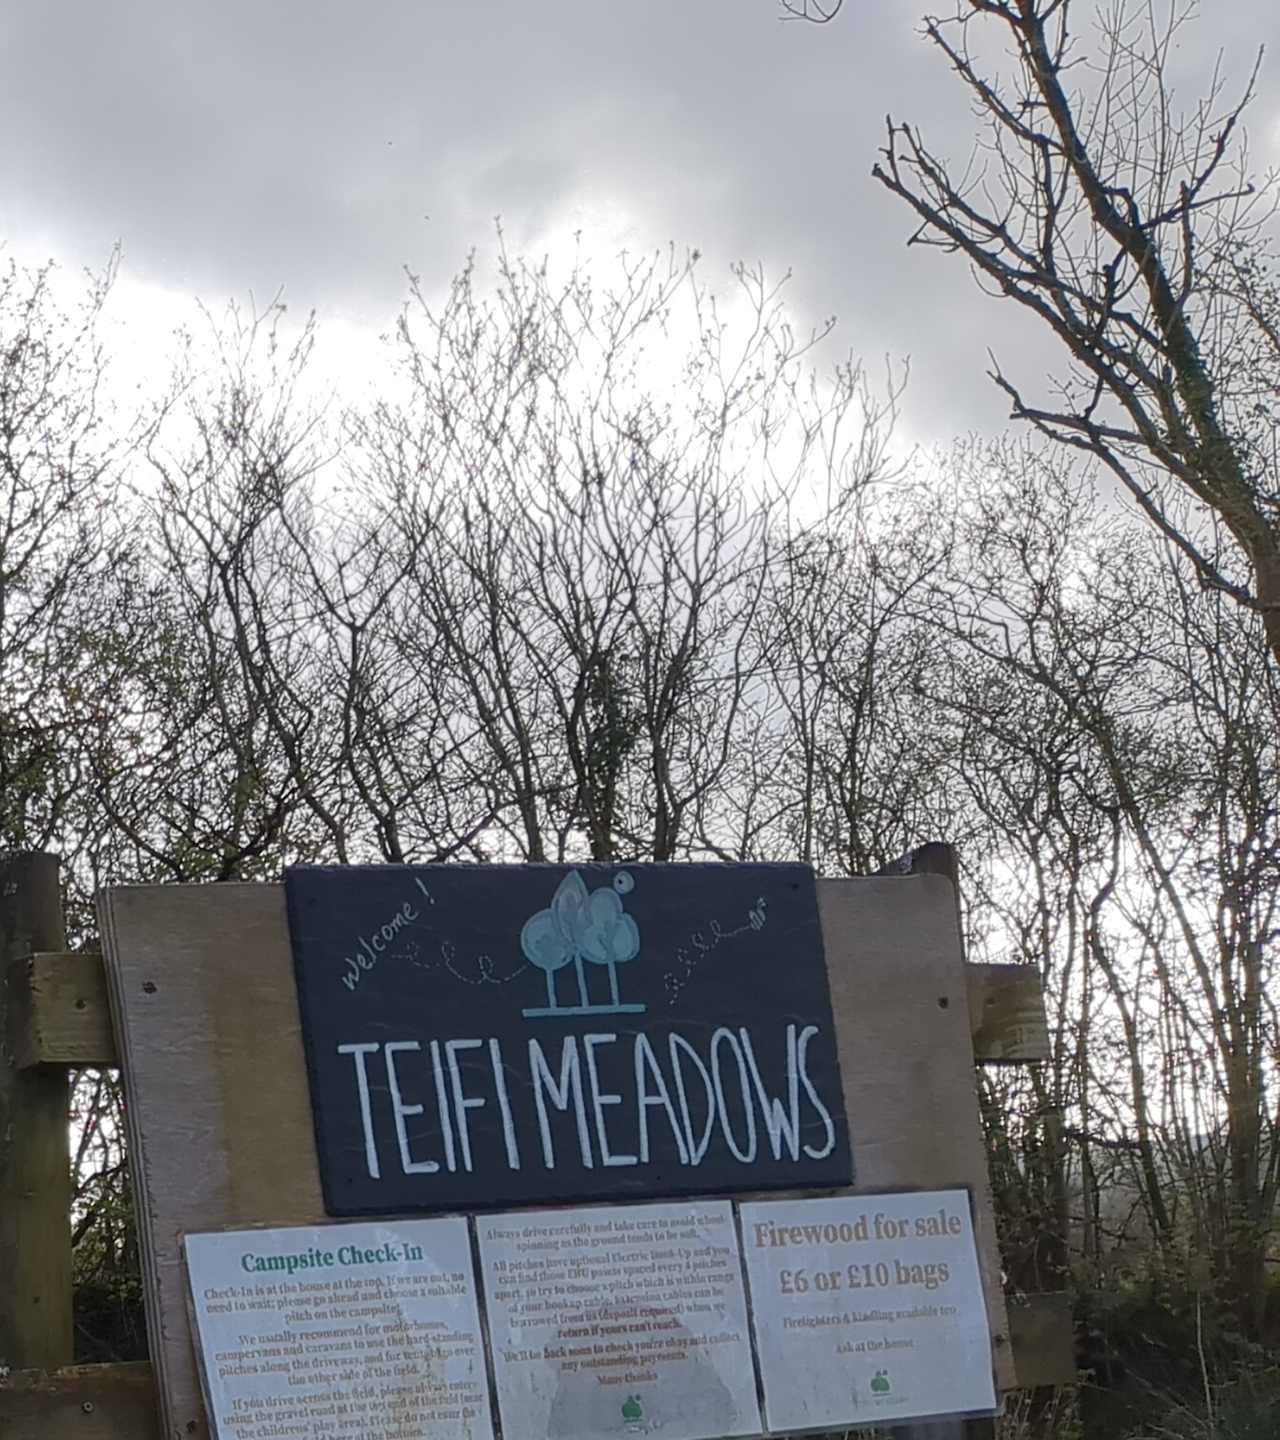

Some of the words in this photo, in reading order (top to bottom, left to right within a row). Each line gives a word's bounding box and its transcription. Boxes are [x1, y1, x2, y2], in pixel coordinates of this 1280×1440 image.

[338, 1037, 520, 1179] TEIFI
[528, 1024, 836, 1170] MEADOWS
[487, 1229, 520, 1242] Always
[522, 1227, 547, 1237] drive
[550, 1223, 591, 1236] carefully
[594, 1221, 612, 1232] and
[614, 1220, 634, 1231] take
[637, 1220, 656, 1229] care
[671, 1215, 696, 1227] avoid
[753, 1214, 869, 1248] Firewood
[873, 1212, 910, 1239] for
[915, 1209, 961, 1237] sale
[517, 1238, 559, 1253] spinning
[574, 1235, 589, 1246] the
[591, 1232, 626, 1248] ground
[240, 1247, 334, 1274] Campsite
[337, 1242, 424, 1267] Check-In
[493, 1260, 506, 1271] All
[509, 1258, 544, 1274] pitches
[546, 1257, 567, 1267] have
[592, 1266, 622, 1280] points
[624, 1262, 656, 1277] spaced
[658, 1262, 682, 1274] every
[780, 1269, 809, 1294] £6
[815, 1270, 841, 1291] or
[848, 1262, 888, 1289] £10
[894, 1259, 949, 1290] bags
[204, 1286, 252, 1299] Check-In
[279, 1283, 296, 1294] the
[298, 1282, 330, 1292] house
[344, 1278, 362, 1289] the
[413, 1275, 428, 1284] are
[538, 1286, 552, 1299] try
[610, 1278, 634, 1294] pitch
[636, 1276, 664, 1288] which
[206, 1301, 232, 1312] need
[278, 1296, 310, 1311] please
[328, 1291, 358, 1304] ahead
[360, 1290, 380, 1301] and
[285, 1309, 312, 1325] pitch
[330, 1307, 347, 1318] the
[784, 1315, 840, 1329] Firelighters
[852, 1310, 894, 1322] kindling
[258, 1330, 297, 1343] usually
[300, 1324, 362, 1339] recommend
[364, 1323, 380, 1334] for
[558, 1327, 589, 1338] return
[600, 1324, 627, 1338] yours
[216, 1347, 281, 1362] campervans
[284, 1343, 302, 1354] and
[305, 1341, 351, 1353] caravans
[368, 1338, 386, 1347] use
[387, 1335, 404, 1346] the
[544, 1346, 566, 1358] back
[606, 1340, 634, 1352] check
[867, 1339, 883, 1350] the
[219, 1364, 258, 1380] pitches
[260, 1361, 290, 1374] along
[292, 1359, 309, 1370] the
[364, 1352, 383, 1363] and
[386, 1351, 400, 1362] for
[288, 1374, 306, 1385] the
[309, 1371, 338, 1383] other
[341, 1369, 360, 1380] side
[375, 1367, 390, 1378] the
[562, 1361, 577, 1372] any
[243, 1398, 264, 1411] you
[266, 1395, 294, 1405] drive
[332, 1389, 350, 1400] the
[380, 1385, 414, 1399] please
[223, 1413, 252, 1426] using
[255, 1410, 272, 1421] the
[274, 1407, 308, 1423] gravel
[310, 1404, 335, 1416] road
[350, 1402, 366, 1413] the
[236, 1427, 255, 1438] the
[312, 1420, 336, 1435] play
[420, 1411, 435, 1422] not
[367, 1430, 383, 1440] the
